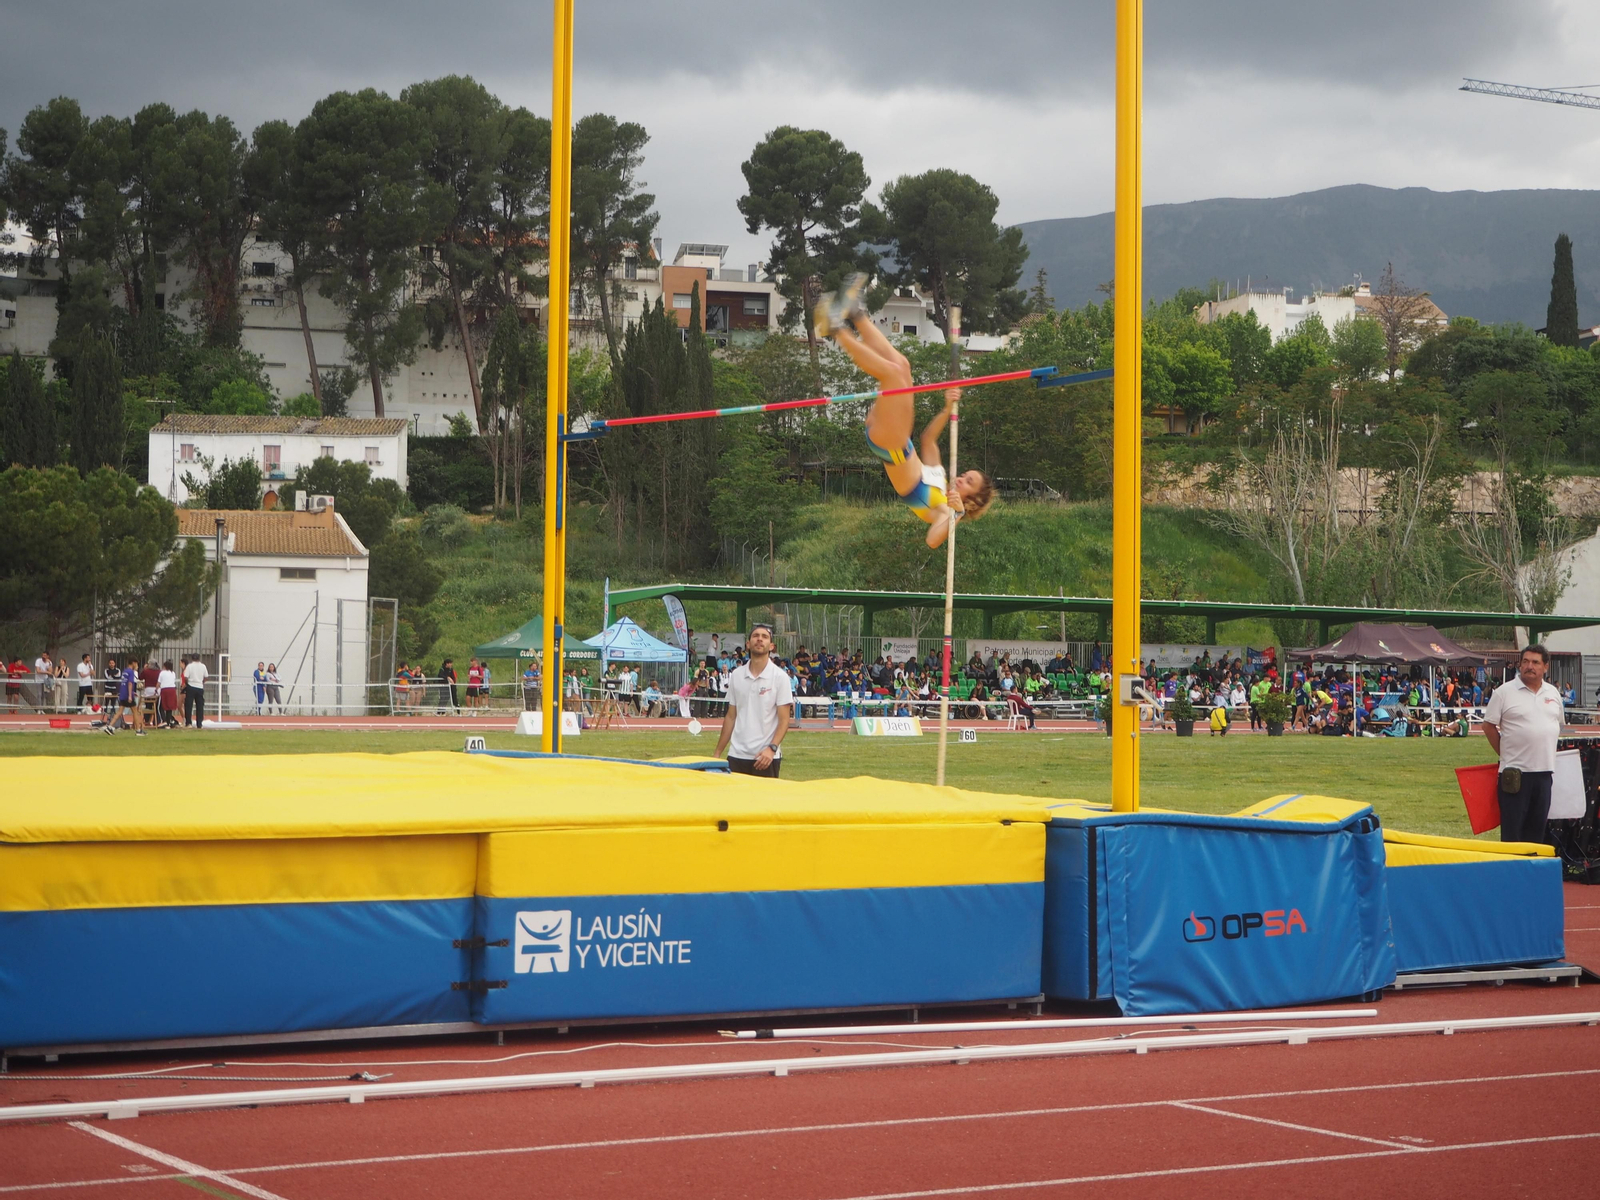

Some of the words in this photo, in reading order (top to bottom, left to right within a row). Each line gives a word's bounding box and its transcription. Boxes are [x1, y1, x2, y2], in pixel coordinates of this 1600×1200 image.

[984, 646, 1020, 656] Patronato
[1021, 647, 1056, 657] Municipal
[1056, 648, 1066, 657] de
[884, 718, 912, 732] Jaén
[964, 730, 975, 741] 60
[469, 739, 484, 750] 40
[576, 907, 662, 941] LAUSÍN
[1221, 908, 1307, 940] OPSA
[575, 944, 592, 969] Y
[595, 940, 692, 968] VICENTE
